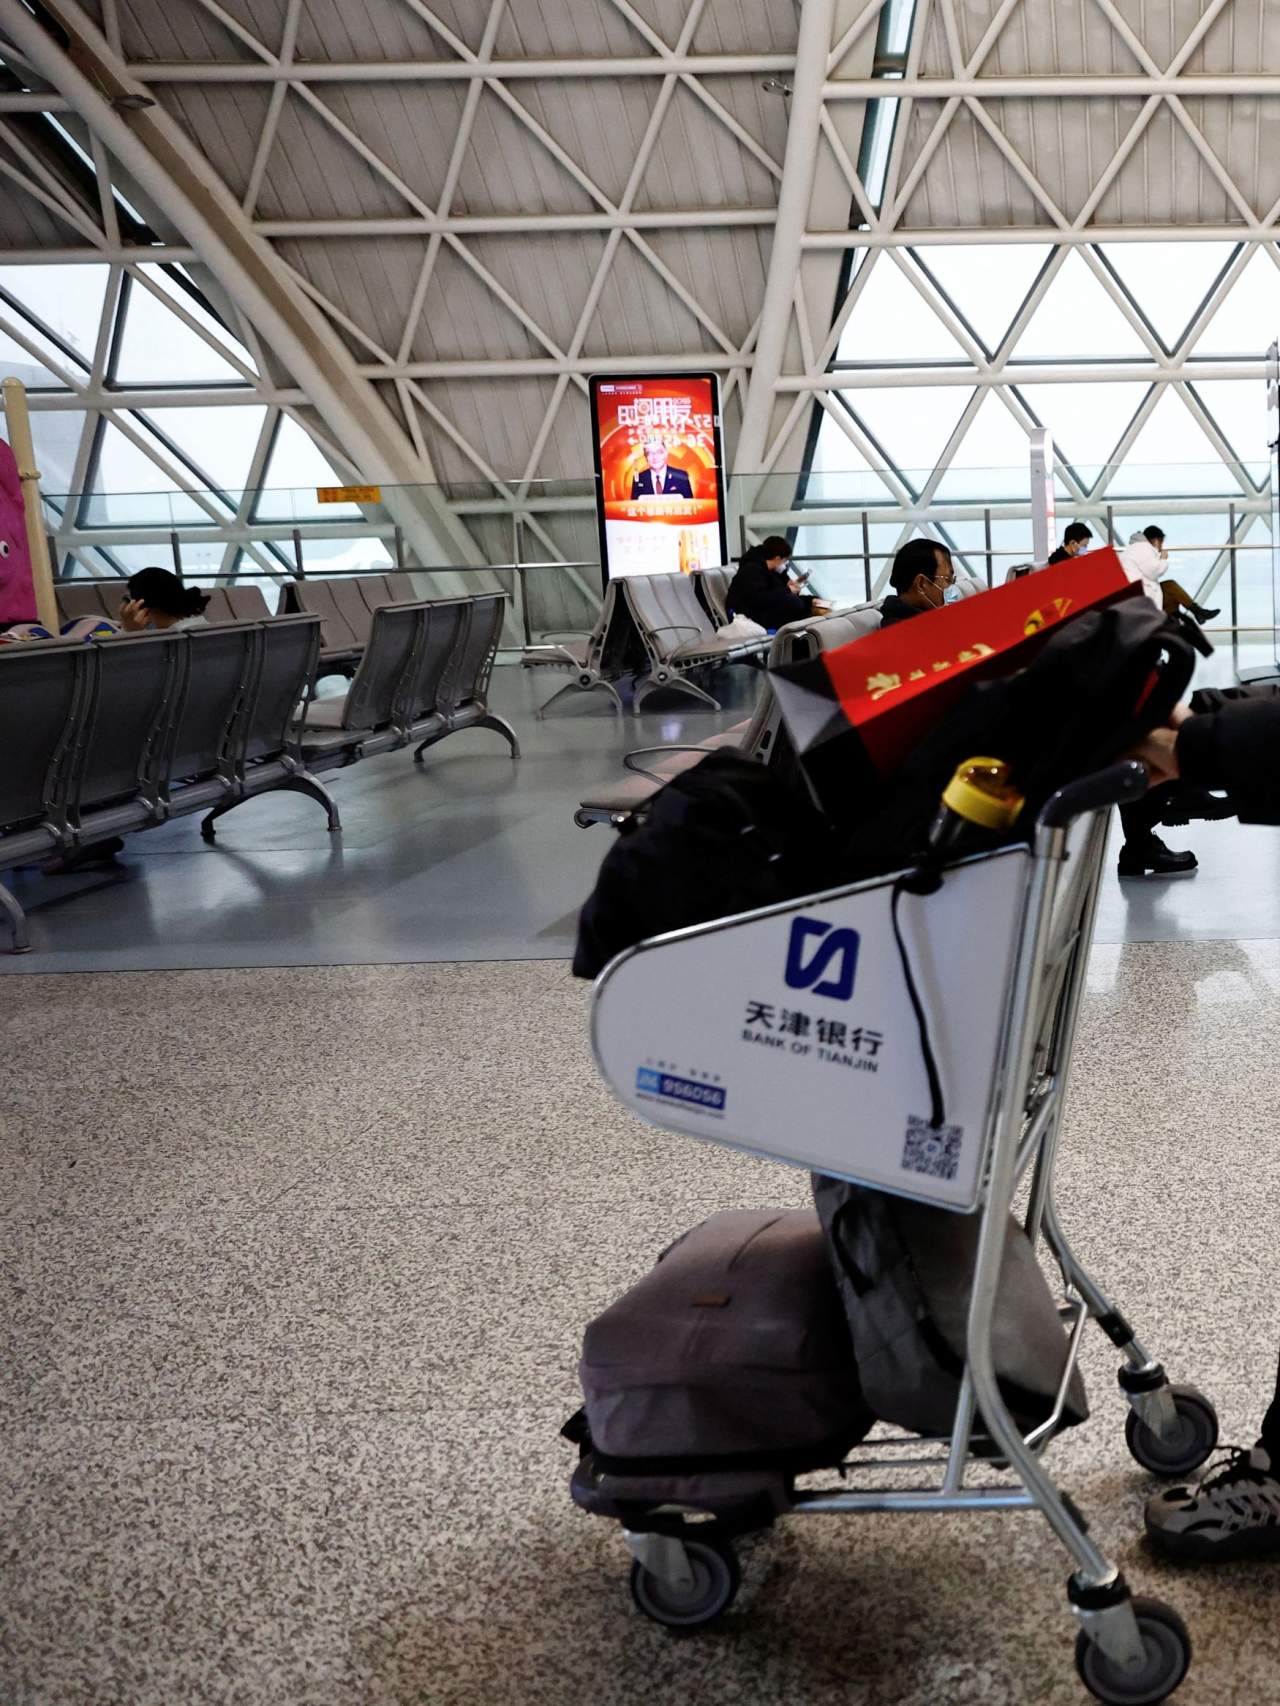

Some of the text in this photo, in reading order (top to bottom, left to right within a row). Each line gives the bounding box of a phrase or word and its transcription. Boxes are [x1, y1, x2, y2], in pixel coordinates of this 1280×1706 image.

[742, 1029, 879, 1073] BANK OF TIANJIN
[746, 1000, 884, 1056] 天津银行
